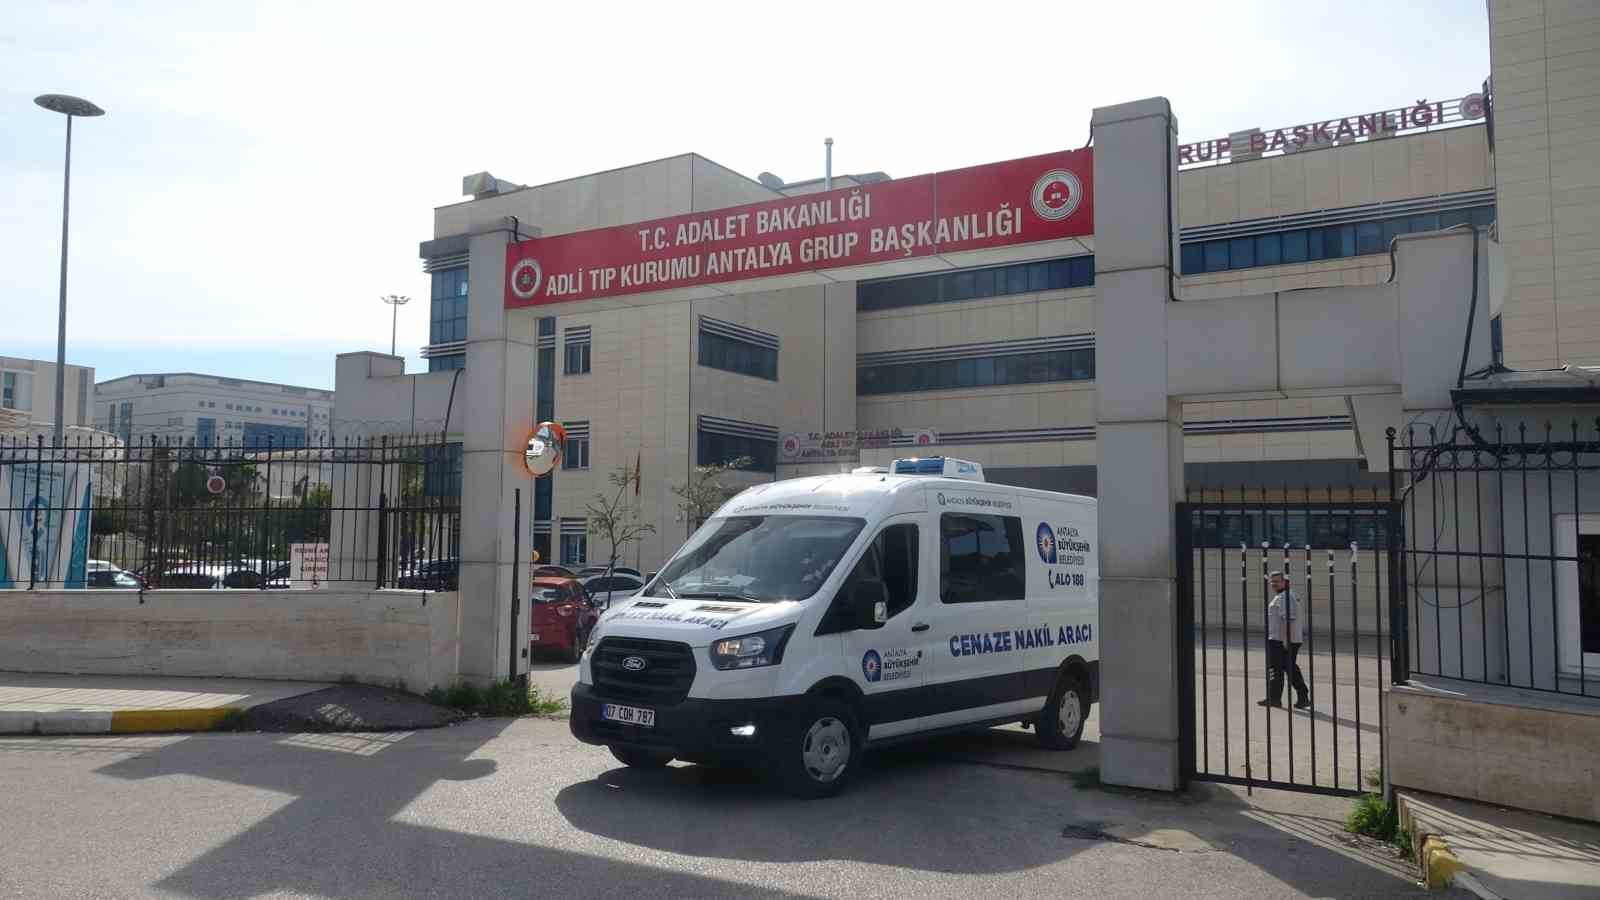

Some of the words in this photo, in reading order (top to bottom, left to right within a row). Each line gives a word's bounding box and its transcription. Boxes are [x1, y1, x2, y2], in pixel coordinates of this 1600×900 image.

[1178, 138, 1231, 164] RUP
[1249, 99, 1443, 153] BAŞKANLIĞI
[639, 227, 671, 252] T.C.
[676, 213, 750, 246] ADALET
[756, 189, 871, 234] BAKANLIĞI
[545, 269, 583, 297] ADLİ
[588, 266, 617, 292] TIP
[621, 254, 700, 288] KURUMU
[707, 243, 793, 275] ANTALYA
[799, 232, 859, 263] GRUP
[870, 202, 1023, 258] BAŞKANLIĞI
[1055, 572, 1071, 586] ALO
[1072, 573, 1085, 586] 188
[949, 630, 1012, 658] CENAZE
[1015, 623, 1055, 650] NAKİL
[1057, 623, 1092, 646] ARACI
[637, 710, 654, 724] 787
